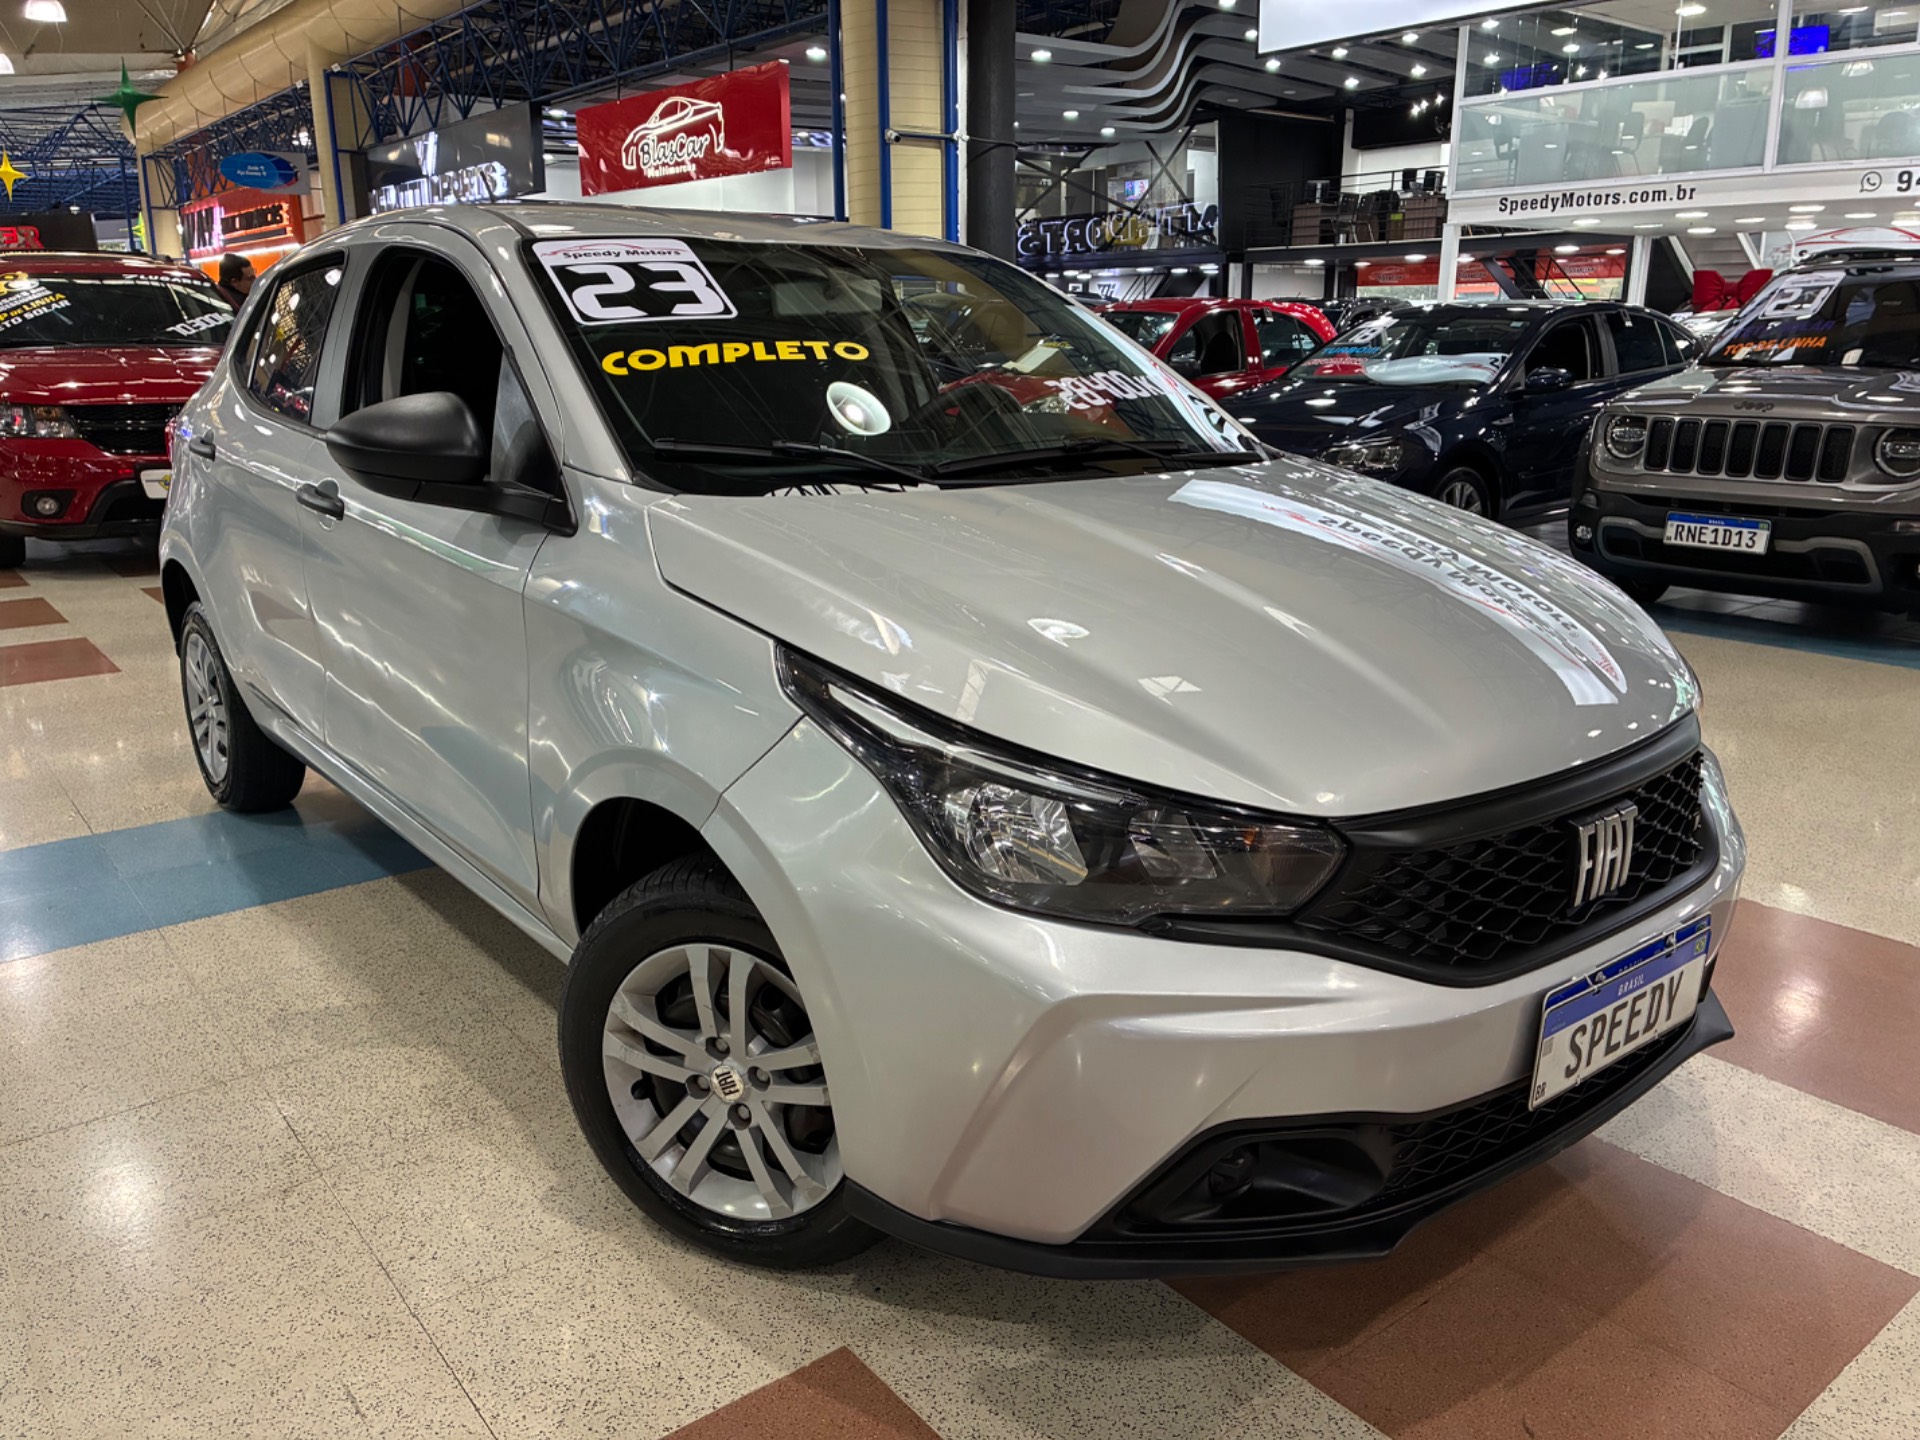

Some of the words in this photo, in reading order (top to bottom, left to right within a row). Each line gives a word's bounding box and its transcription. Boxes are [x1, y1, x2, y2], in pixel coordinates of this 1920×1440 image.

[639, 132, 710, 169] BlasCar
[1896, 170, 1920, 192] 9
[1499, 184, 1697, 215] SpeedyMotors.com.br
[562, 249, 621, 259] Speedy
[625, 248, 682, 257] Motors
[22, 293, 67, 311] LINHA
[564, 261, 726, 319] 23
[23, 299, 72, 320] SOLAR
[1777, 336, 1828, 350] LINHA
[601, 340, 870, 376] COMPLETO
[1733, 400, 1775, 413] Jeep
[1673, 523, 1758, 549] RNE1D13
[1569, 803, 1638, 908] FIAT
[1617, 973, 1645, 996] BRASIL
[1564, 970, 1685, 1079] SPEEDY
[714, 1071, 739, 1096] FIAT
